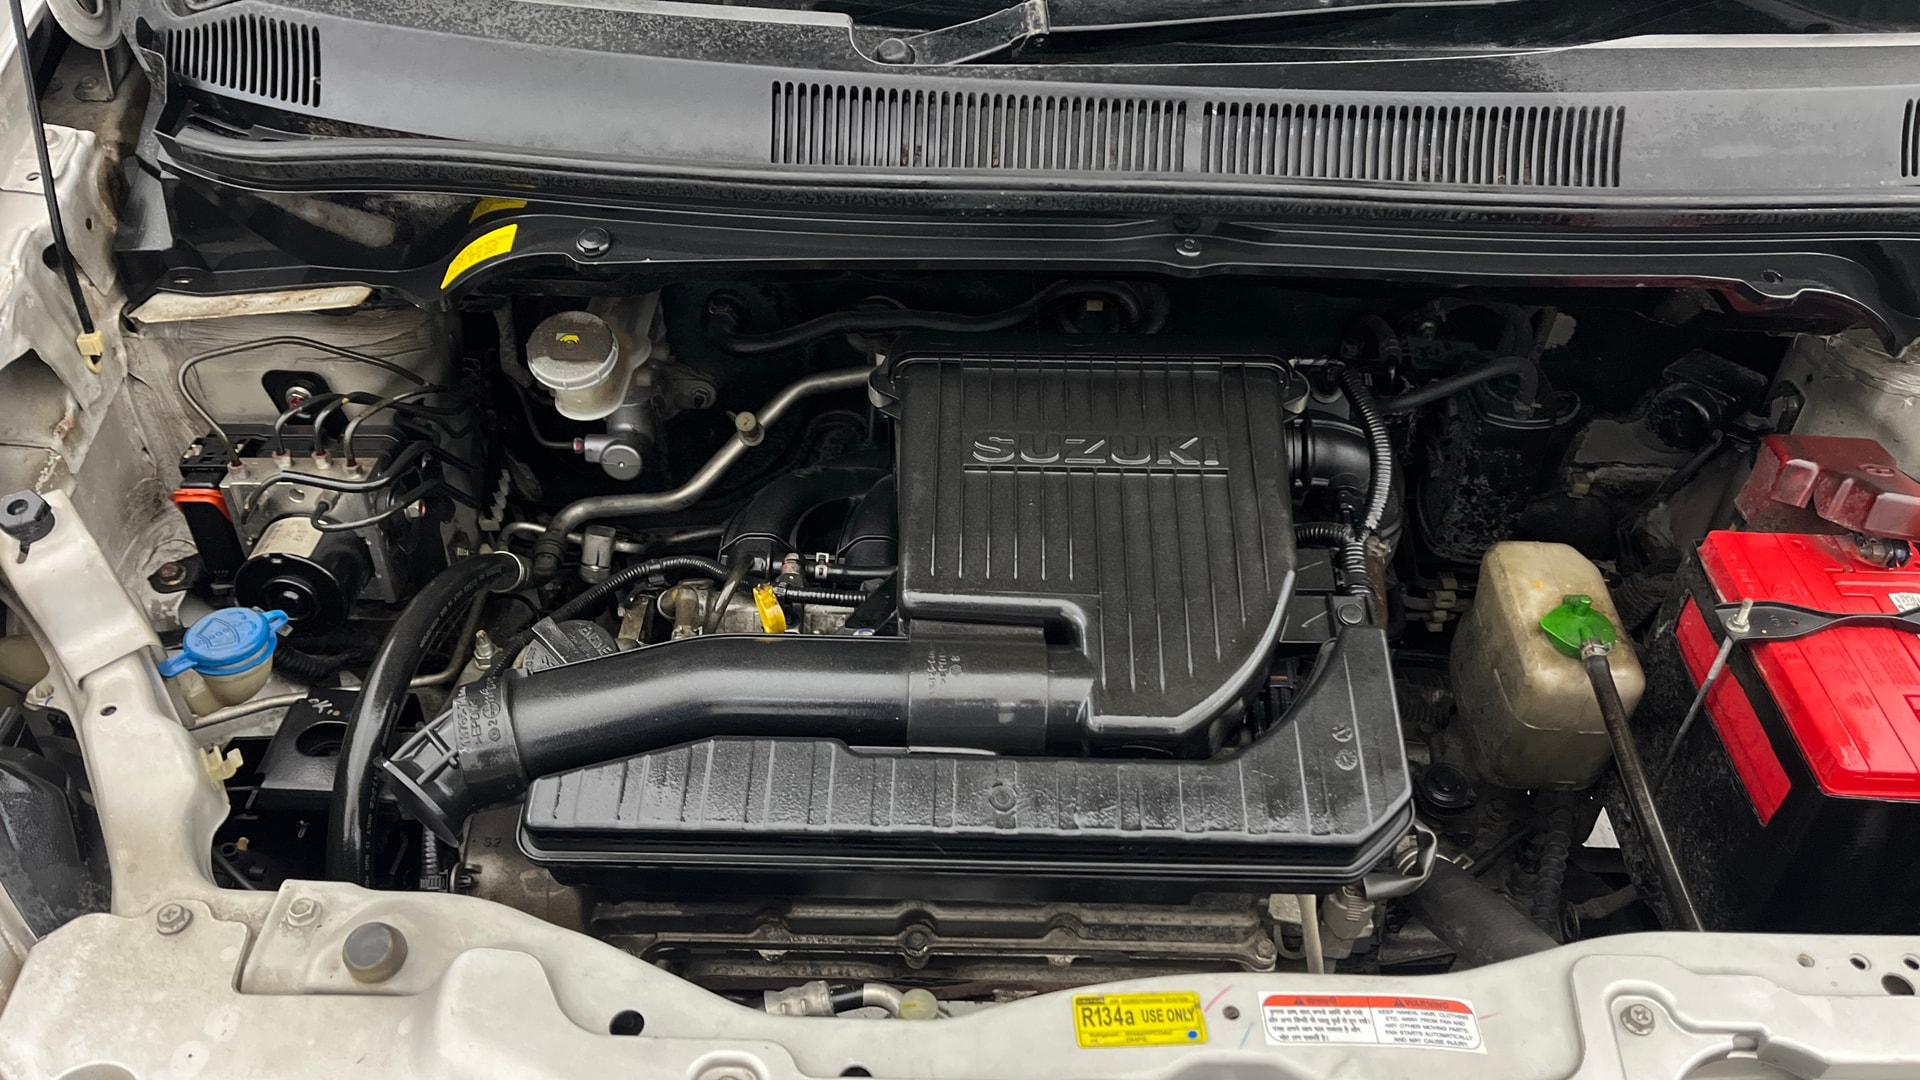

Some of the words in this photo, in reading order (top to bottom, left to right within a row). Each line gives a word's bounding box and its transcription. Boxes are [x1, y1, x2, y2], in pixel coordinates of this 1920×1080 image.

[972, 432, 1219, 465] SUZUKI
[1405, 1000, 1449, 1009] WARNING
[1081, 1006, 1135, 1028] R134a
[1140, 1008, 1164, 1023] USE
[1166, 1007, 1195, 1023] ONLY
[1425, 1031, 1473, 1041] AUTOMATICALLY
